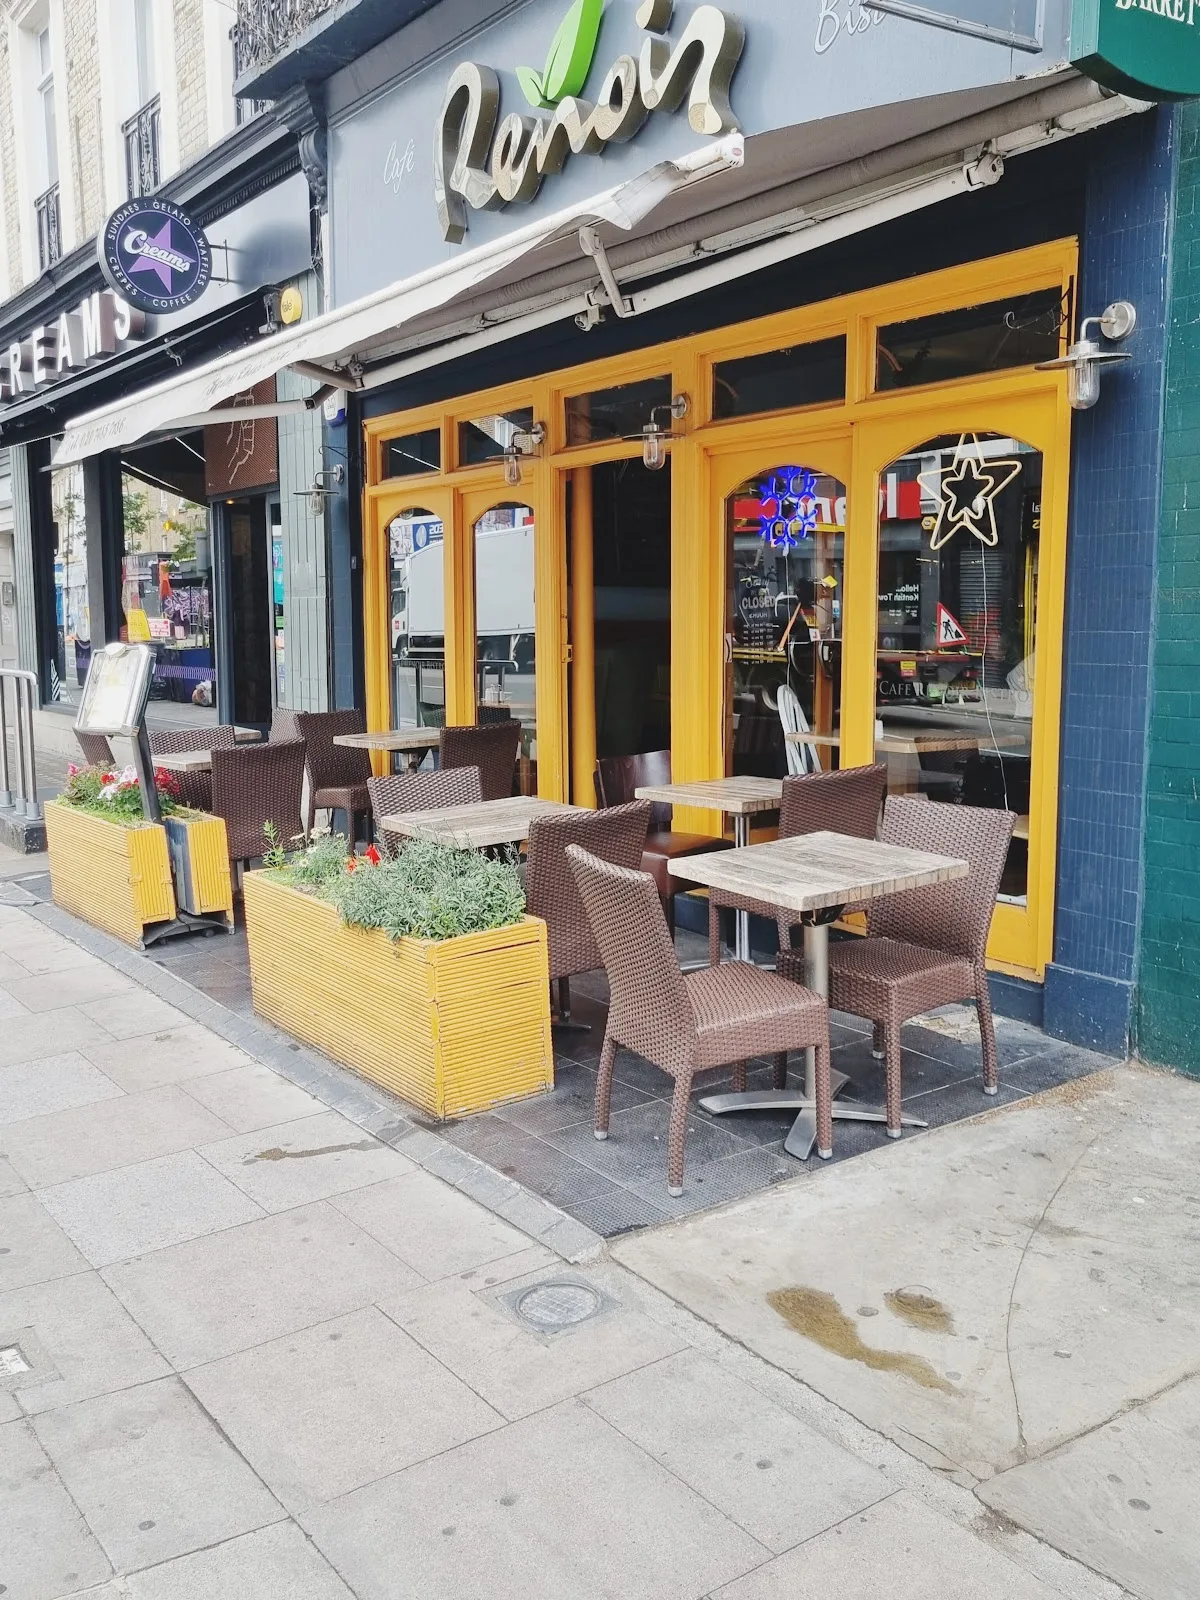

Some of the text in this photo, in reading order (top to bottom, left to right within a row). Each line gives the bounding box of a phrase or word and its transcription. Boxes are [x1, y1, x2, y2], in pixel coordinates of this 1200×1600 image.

[383, 137, 416, 194] Café
[107, 202, 140, 241] SUNDAES
[152, 199, 192, 226] GELATO
[123, 229, 191, 273] Creams
[196, 237, 209, 287] WAFFLES
[108, 256, 138, 296] CREPES
[152, 293, 193, 308] COFFEE
[741, 595, 776, 610] CLOSED
